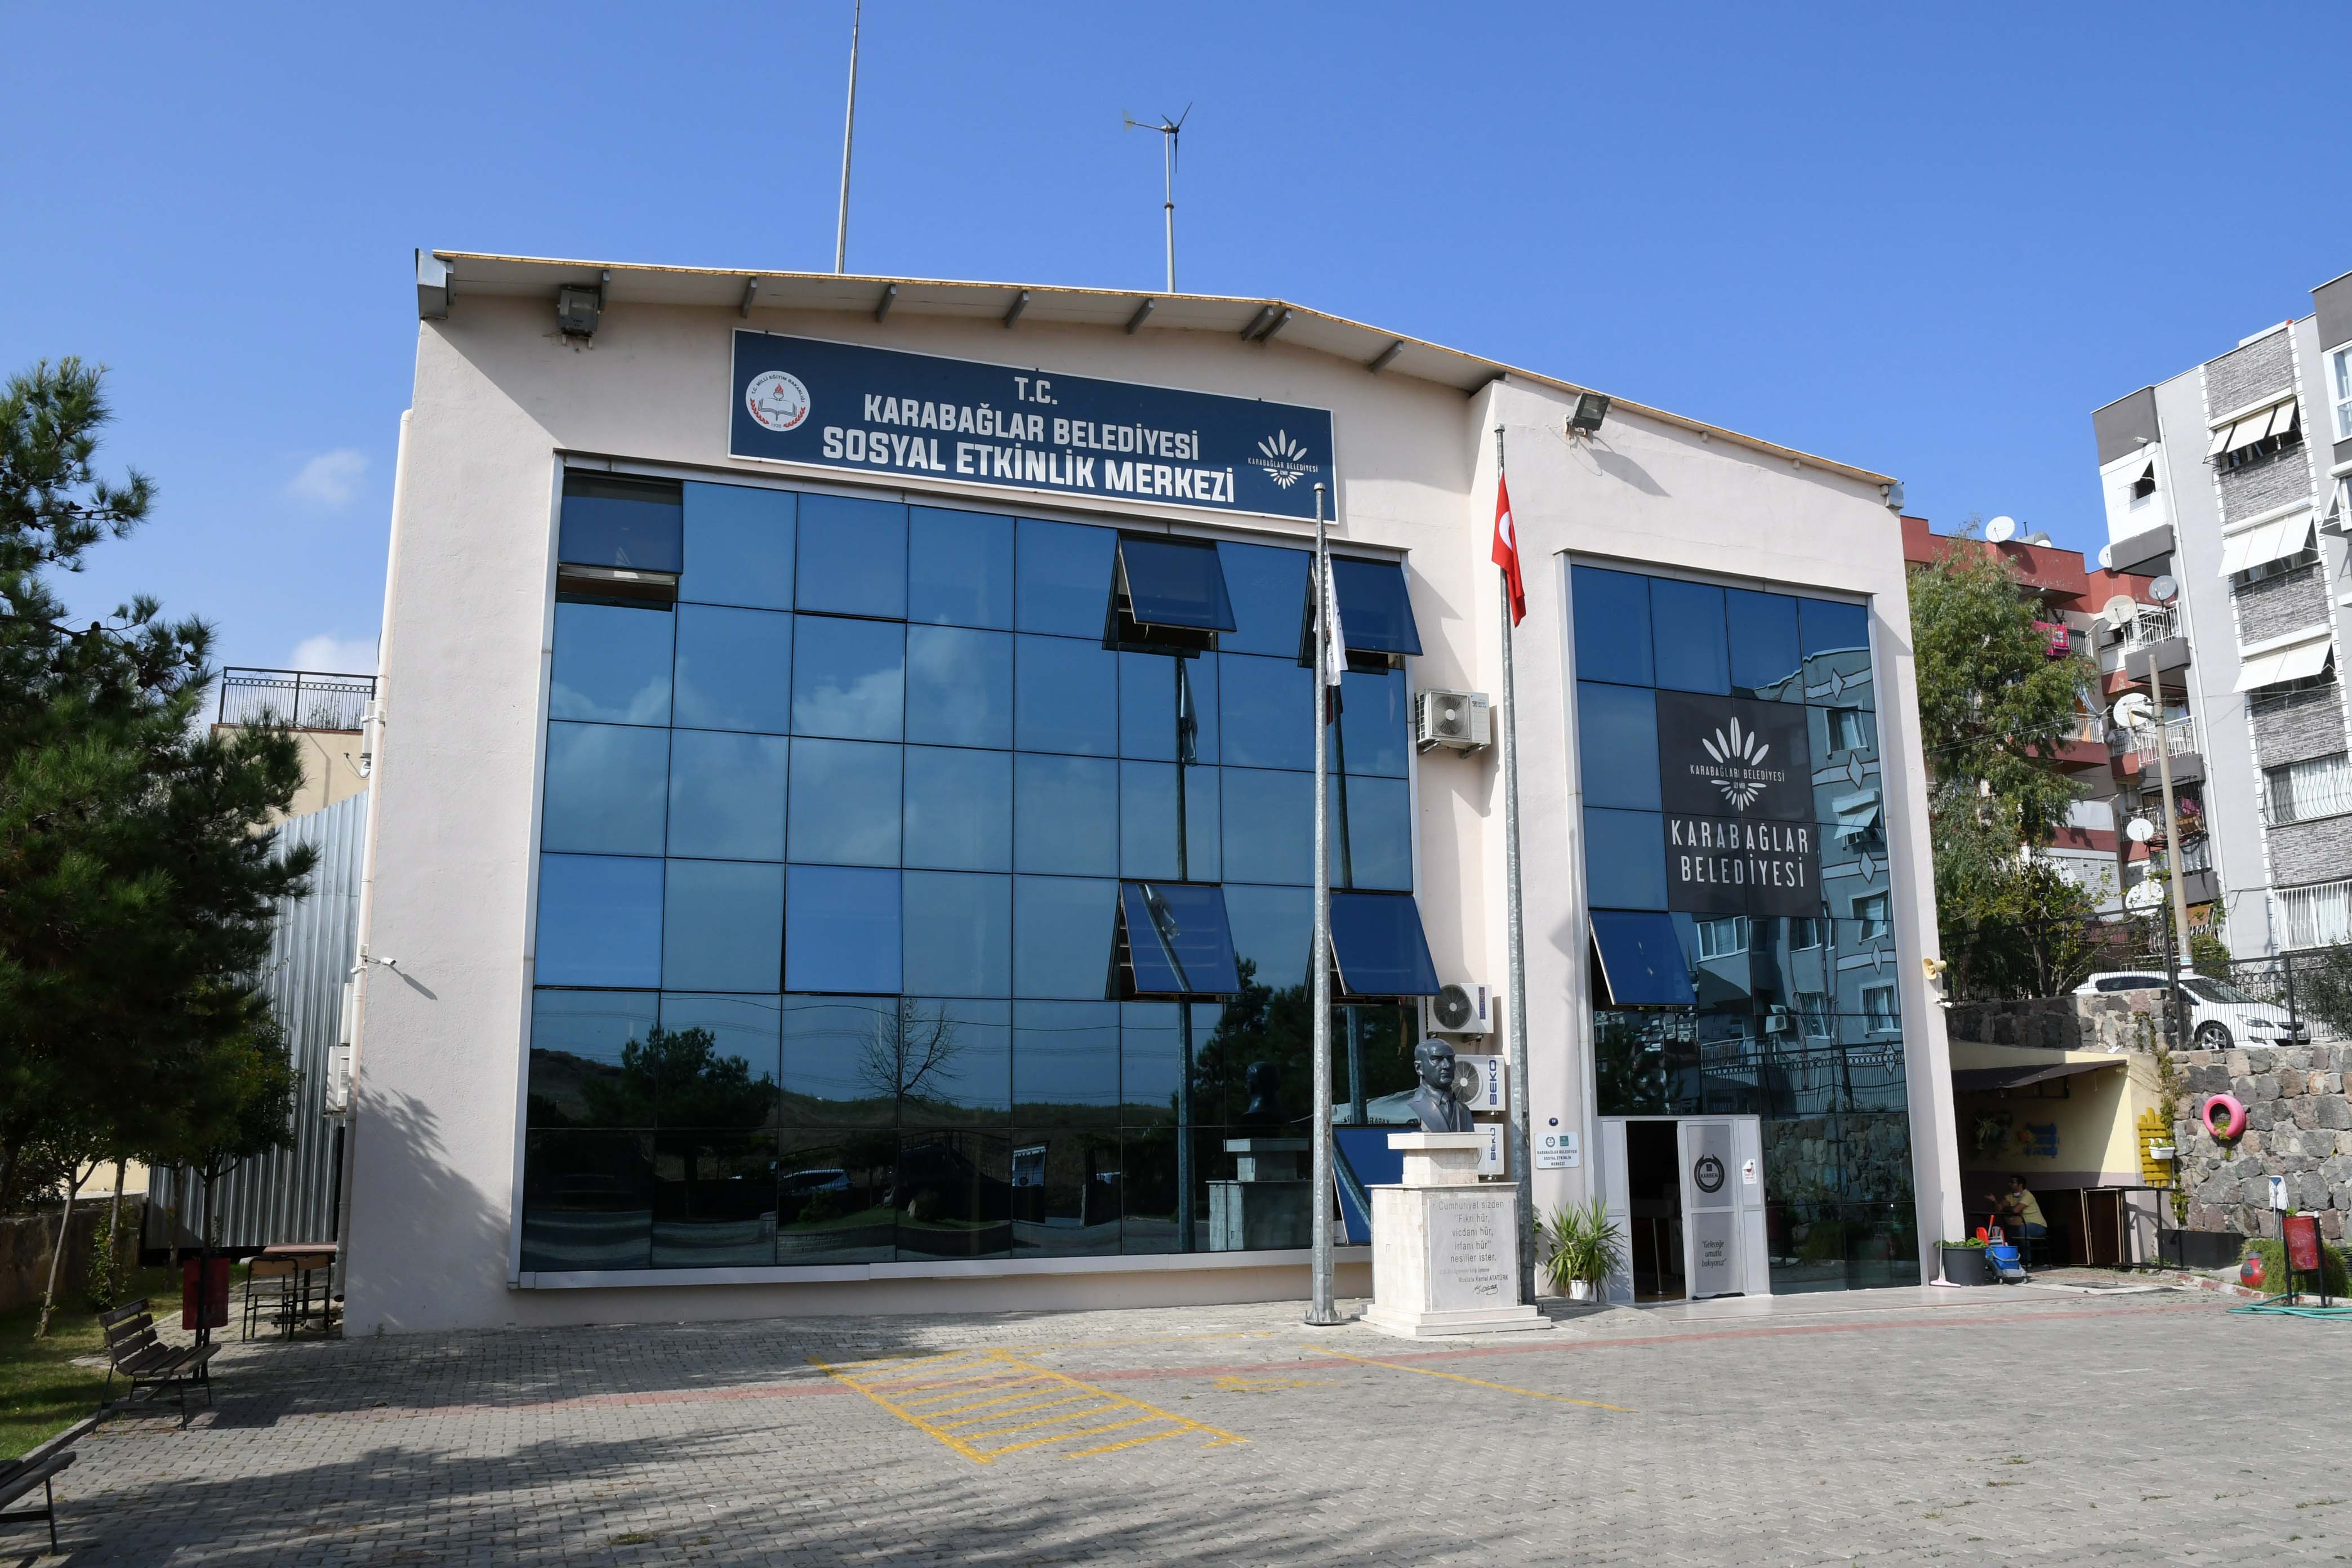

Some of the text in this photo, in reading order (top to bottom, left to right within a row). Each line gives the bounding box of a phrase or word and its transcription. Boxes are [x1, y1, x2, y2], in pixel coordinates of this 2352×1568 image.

[1014, 376, 1058, 404] T.C.
[865, 394, 1199, 461] KARABAĞLAR BELEDİYESİ
[823, 426, 1234, 503] SOSYAL ETKİNLİK MERKEZİ
[1248, 457, 1318, 473] KARABAĞLAR BELEDİYESİ
[1690, 764, 1785, 782] KARABAĞLAR BELEDİYESİ
[1671, 819, 1808, 853] KARABAĞLAR
[1681, 854, 1804, 887] BELEDİYESİ
[1489, 1059, 1498, 1105] BEKO
[1438, 1200, 1504, 1211] Cumhuriyet sizden
[1451, 1253, 1496, 1263] nesiller ister.
